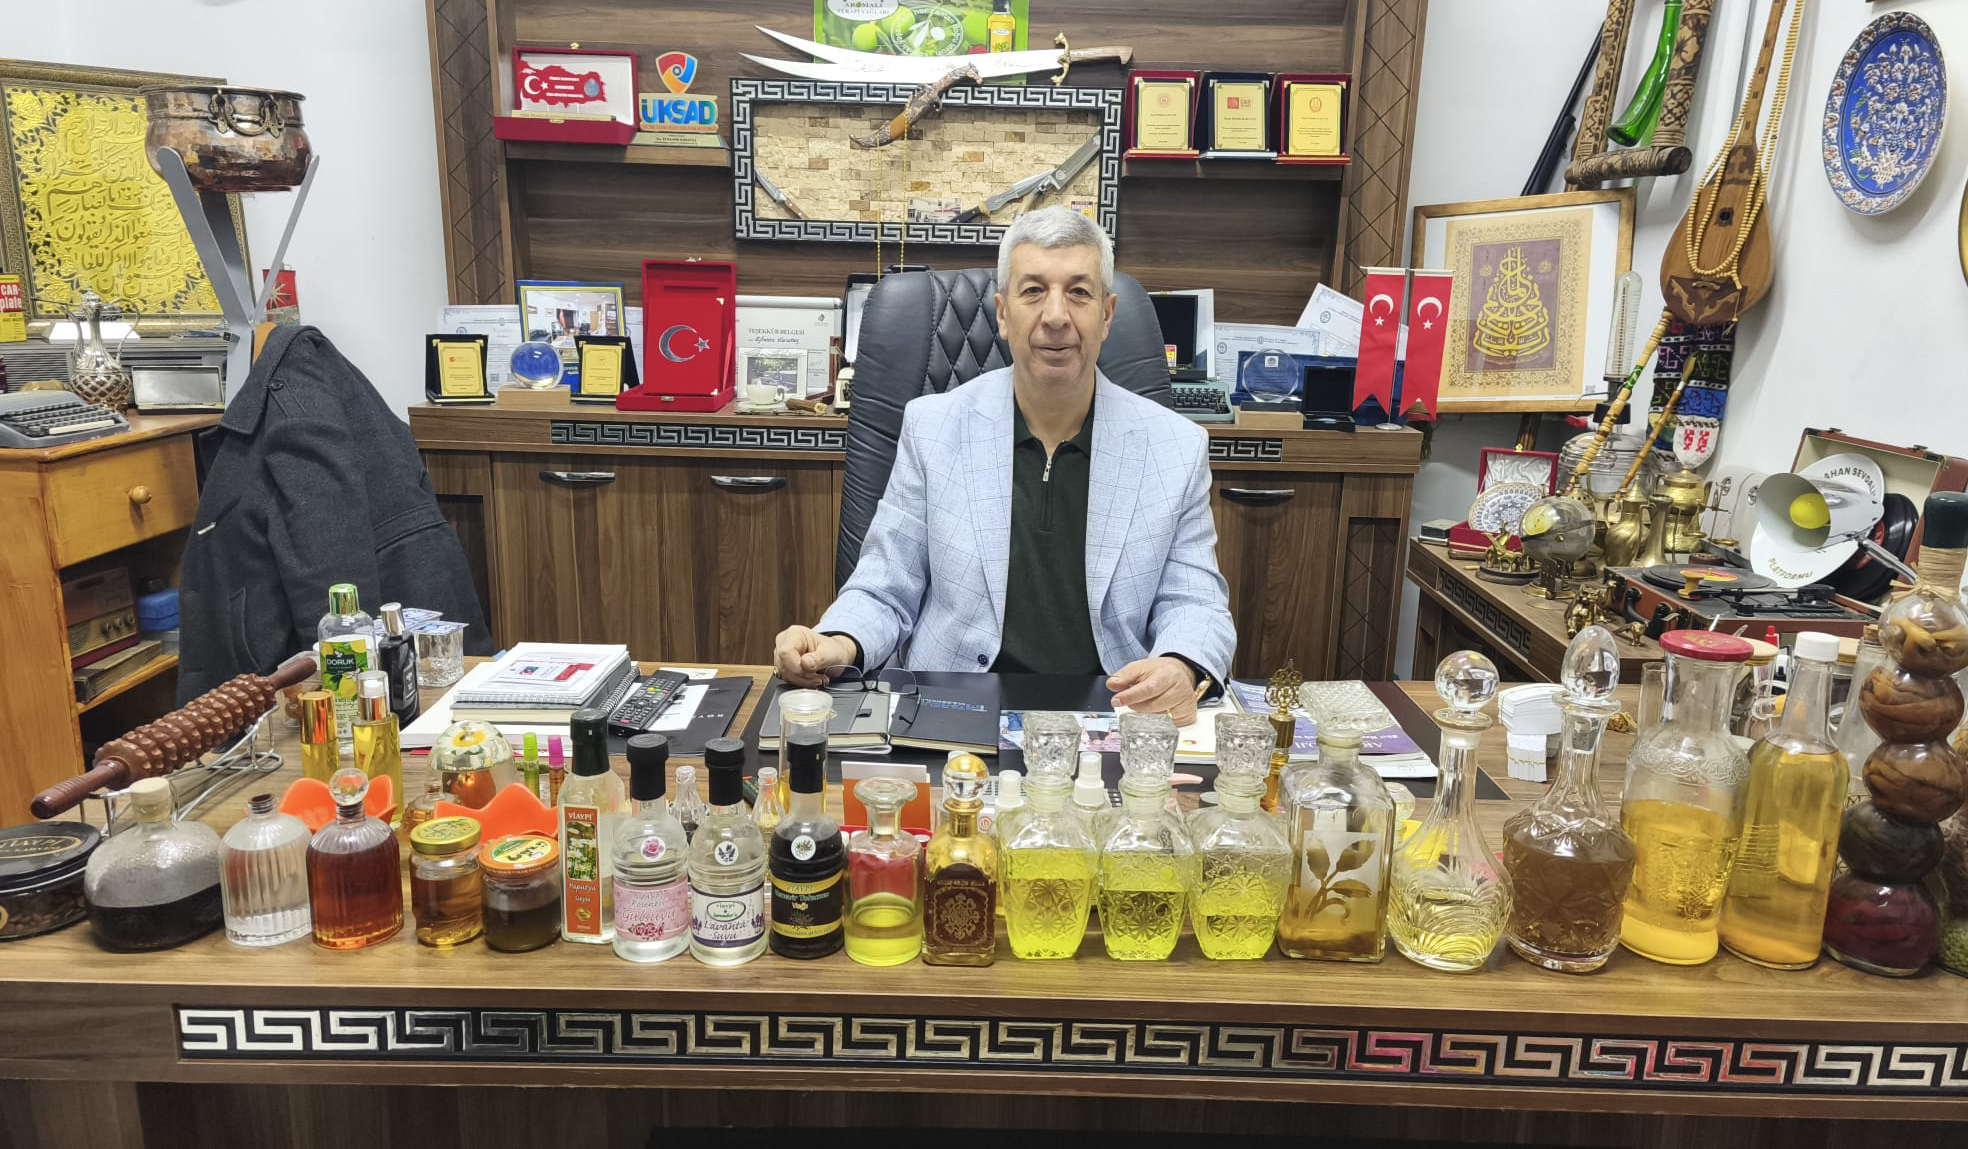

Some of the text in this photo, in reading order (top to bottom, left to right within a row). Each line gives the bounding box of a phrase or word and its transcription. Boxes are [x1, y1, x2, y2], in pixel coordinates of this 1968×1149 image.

[641, 98, 717, 125] ÜKSAD
[0, 284, 21, 296] CAR-
[1767, 557, 1814, 580] PLATFORMU
[326, 657, 354, 666] DORUK
[703, 920, 747, 931] Lavanta
